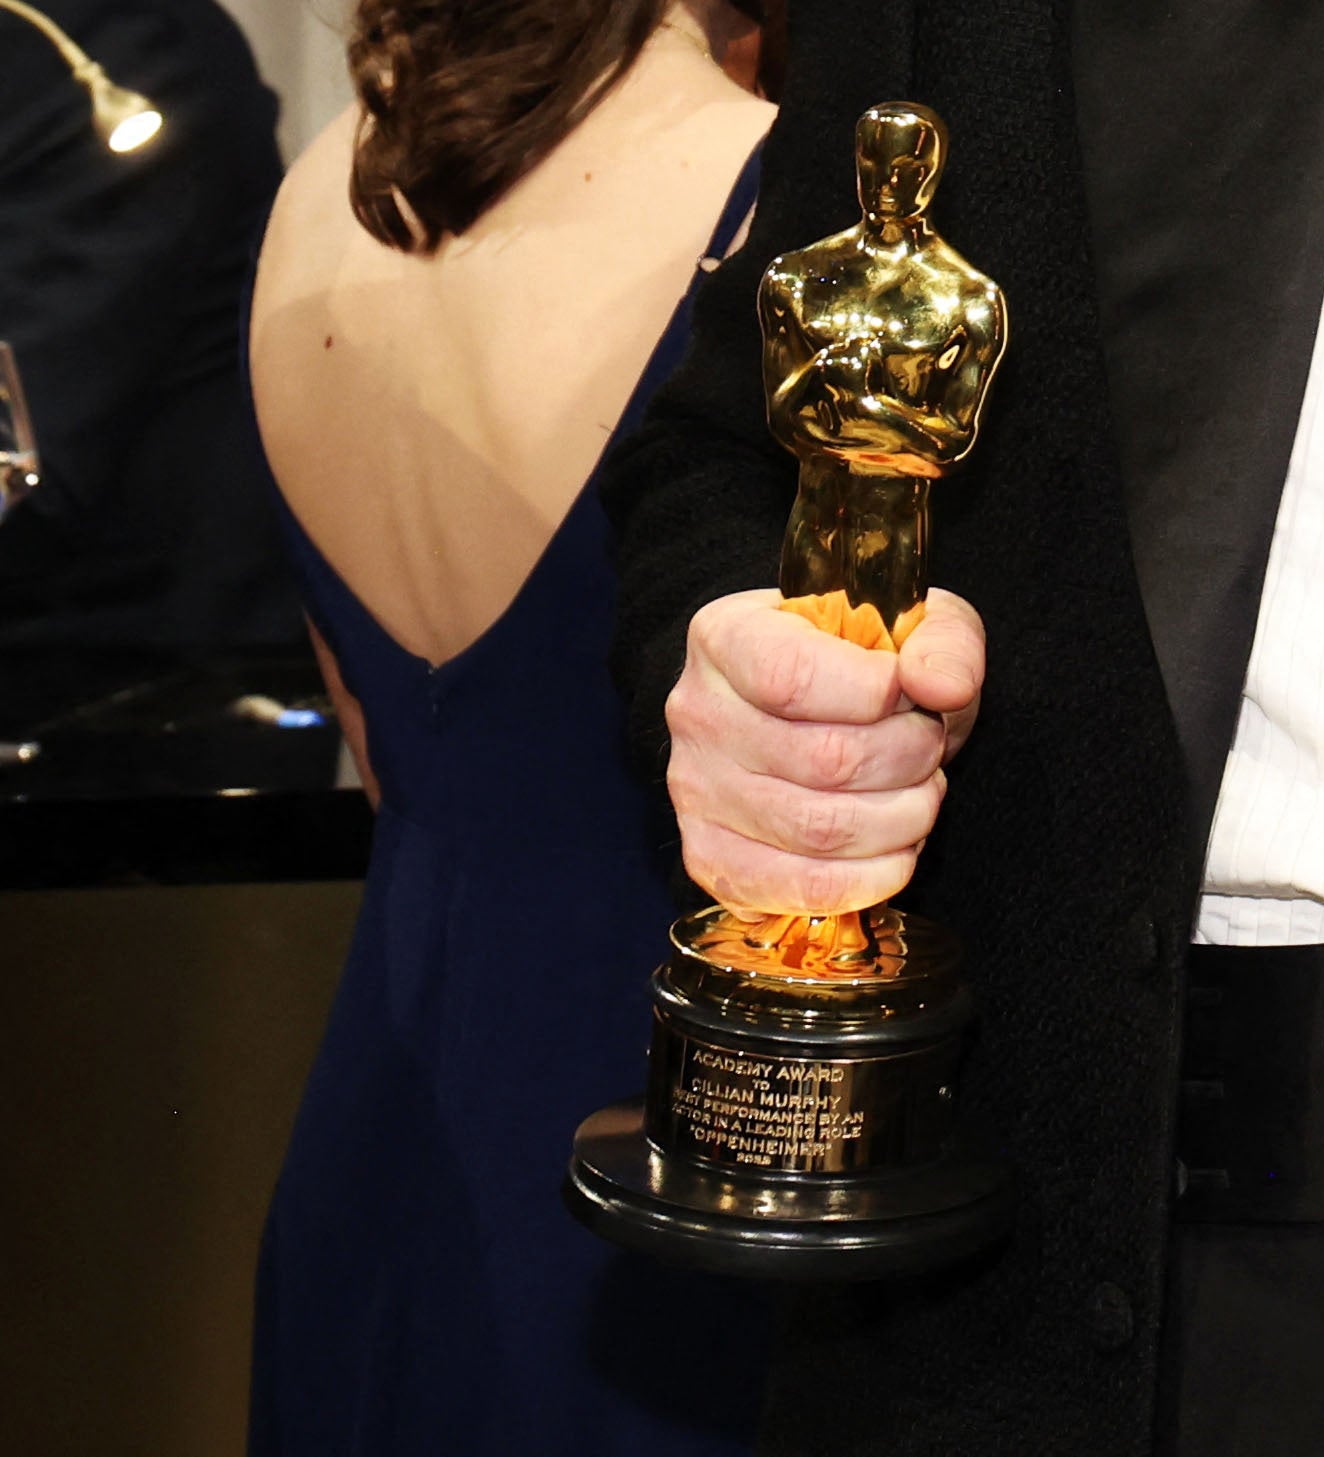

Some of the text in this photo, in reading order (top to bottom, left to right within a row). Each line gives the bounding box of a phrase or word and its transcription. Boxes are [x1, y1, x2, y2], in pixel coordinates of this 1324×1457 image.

[693, 1048, 844, 1082] ACADEMY AWARD
[691, 1078, 841, 1110] CILLIAN MURPHY
[752, 1079, 770, 1091] TO
[703, 1098, 816, 1124] PERFORMANCE
[819, 1112, 840, 1125] BY
[841, 1111, 864, 1124] AN
[714, 1115, 729, 1129] IN
[731, 1121, 742, 1132] A
[746, 1122, 816, 1140] LEADING
[819, 1126, 862, 1140] ROLE
